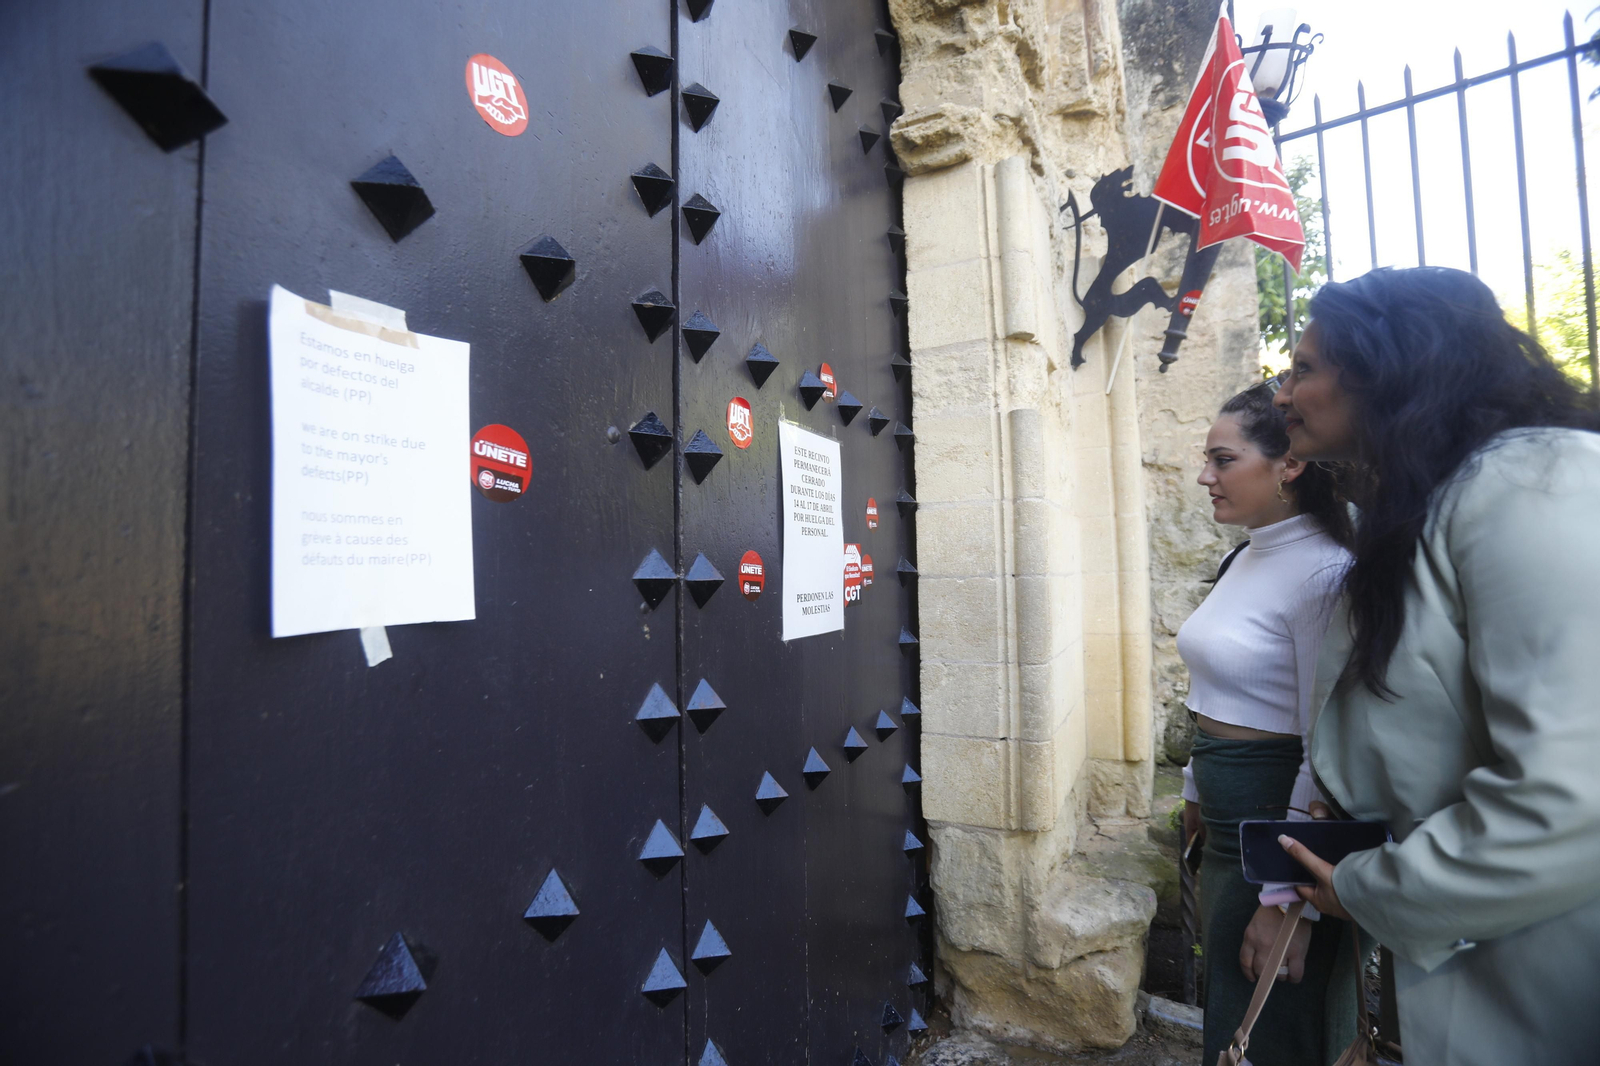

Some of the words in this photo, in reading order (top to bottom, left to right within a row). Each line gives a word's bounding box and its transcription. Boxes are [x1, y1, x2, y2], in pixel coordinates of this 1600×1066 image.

[472, 61, 519, 107] UGT
[300, 331, 349, 359] Estamos
[353, 351, 371, 362] en
[375, 353, 415, 374] huelga
[300, 356, 319, 371] por
[322, 363, 377, 385] defectos
[380, 375, 399, 389] del
[301, 377, 339, 398] alcalde
[343, 387, 371, 405] (PP)
[730, 402, 750, 428] UGT
[319, 427, 338, 439] are
[342, 431, 359, 442] on
[364, 433, 397, 447] strike
[401, 437, 426, 450] due
[301, 443, 313, 455] to
[315, 445, 333, 459] the
[337, 451, 388, 466] mayor's
[474, 440, 527, 468] ÚNETE
[794, 446, 807, 458] ESTE
[808, 450, 830, 464] RECINTO
[301, 464, 369, 486] defects(PP)
[793, 459, 831, 477] PERMANECERÁ
[496, 478, 519, 489] LUCHA
[801, 474, 825, 487] CERRADO
[790, 484, 814, 498] DURANTE
[815, 490, 825, 500] LOS
[825, 491, 836, 502] DÍAS
[794, 499, 800, 508] 14
[800, 499, 807, 509] AL
[807, 501, 812, 510] 17
[812, 502, 819, 511] DE
[820, 504, 834, 513] ABRIL
[302, 510, 328, 522] nous
[330, 513, 384, 525] sommes
[387, 516, 403, 526] en
[793, 512, 805, 522] POR
[805, 513, 825, 525] HUELGA
[826, 517, 835, 526] DEL
[301, 531, 332, 546] grève
[345, 535, 383, 545] cause
[386, 534, 408, 546] des
[302, 552, 343, 566] défauts
[346, 553, 364, 565] du
[368, 552, 432, 567] maire(PP)
[741, 563, 762, 575] ÚNETE
[796, 592, 824, 603] PERDONEN
[825, 591, 834, 601] LAS
[845, 585, 861, 602] CGT
[802, 604, 831, 616] MOLESTIAS
